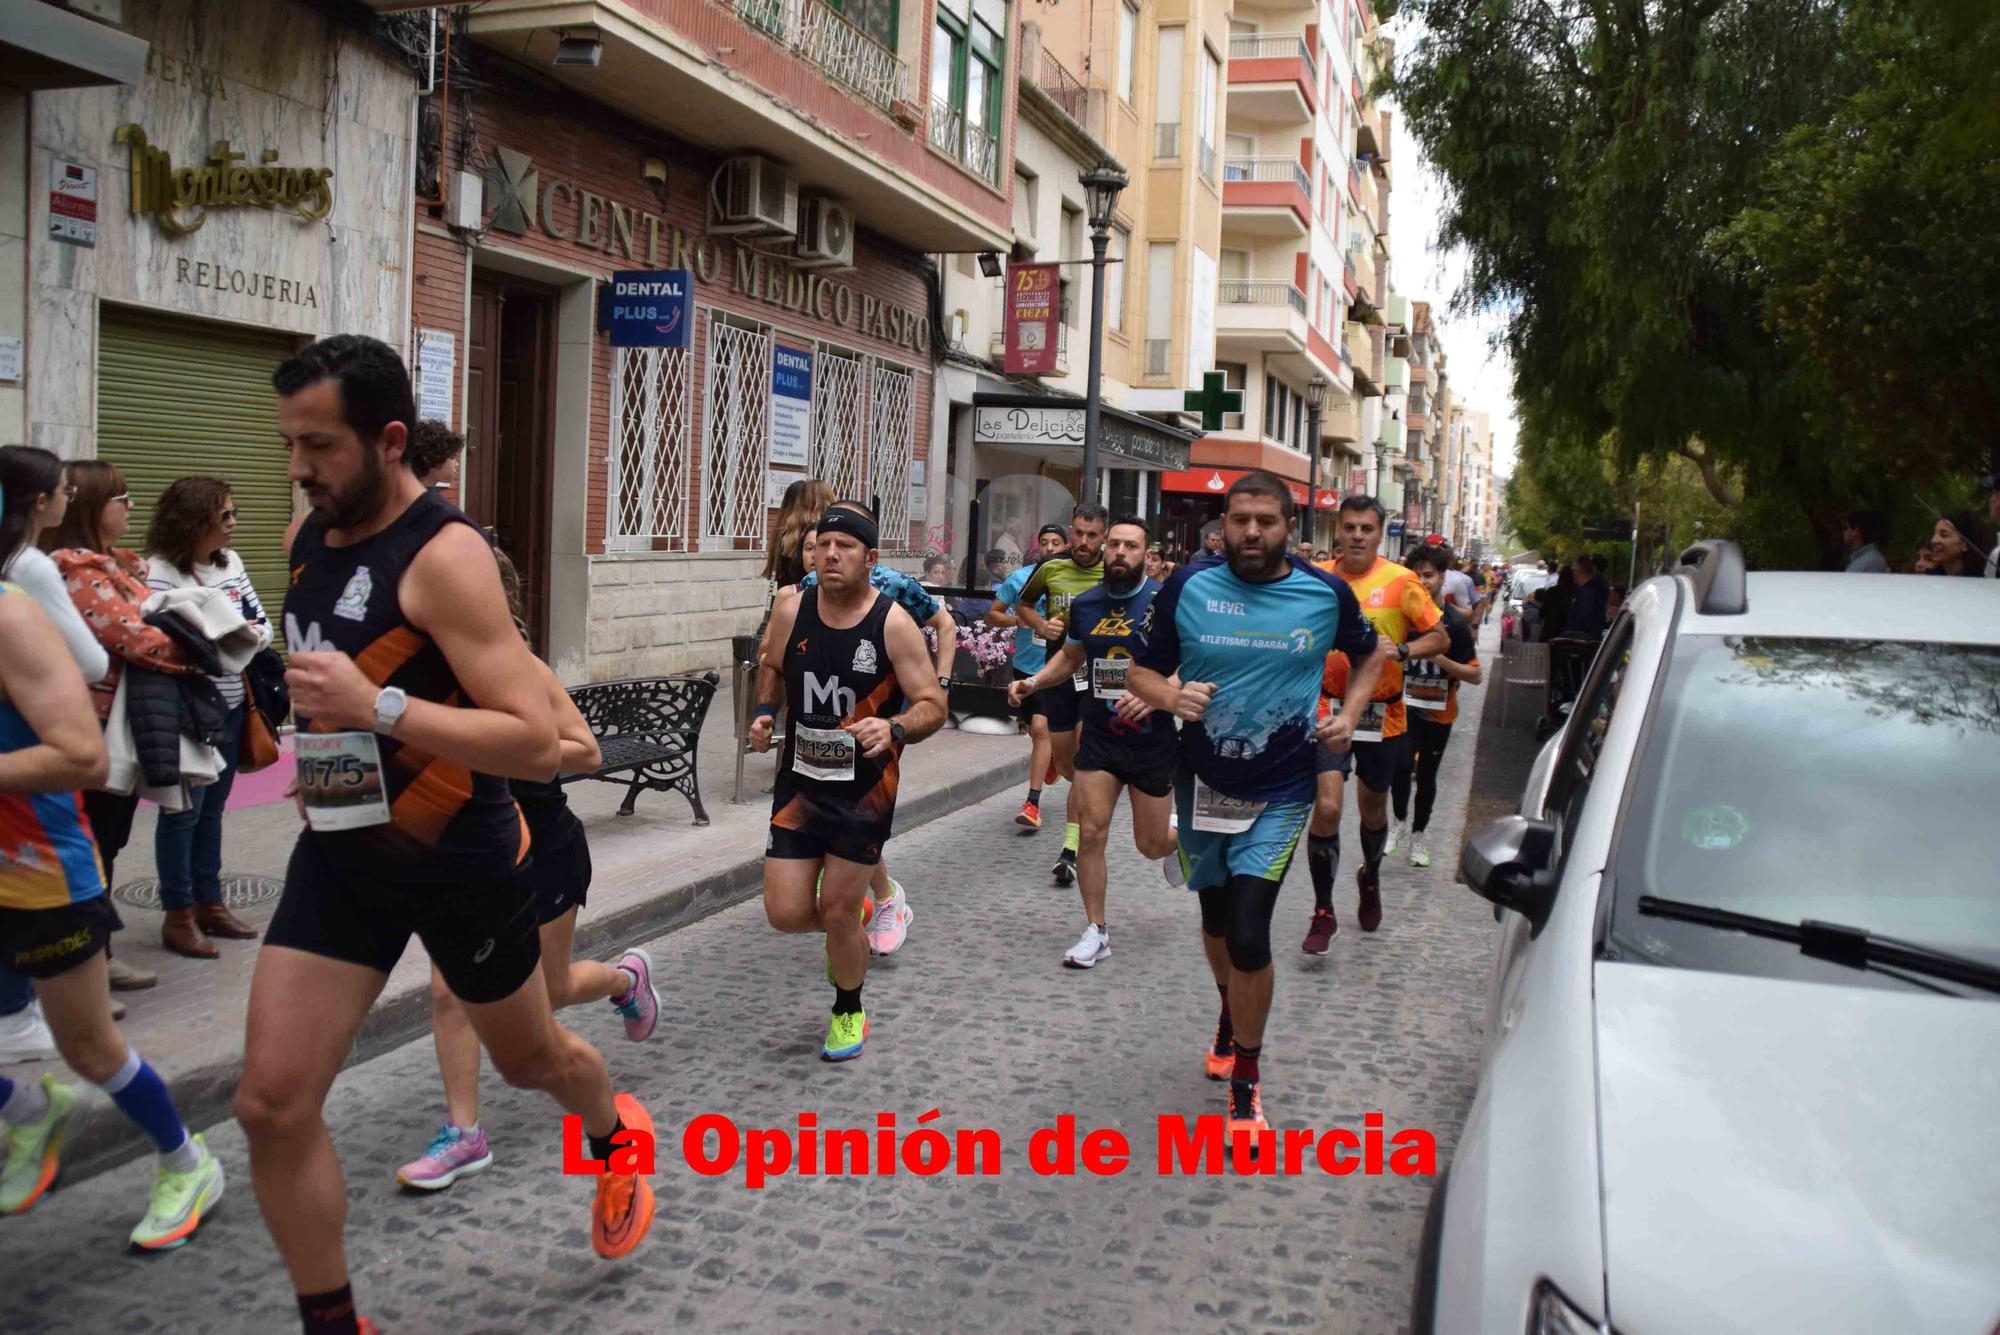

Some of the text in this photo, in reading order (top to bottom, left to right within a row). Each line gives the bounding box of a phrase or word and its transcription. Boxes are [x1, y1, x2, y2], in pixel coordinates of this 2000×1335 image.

[114, 123, 334, 232] Montesinos
[543, 179, 931, 352] CENTRO MEDICO PASEO
[176, 257, 318, 309] RELOJERIA
[615, 282, 684, 297] DENTAL
[613, 306, 658, 320] PLUS
[776, 351, 810, 372] DENTAL
[775, 371, 799, 388] PLUS
[976, 408, 1085, 438] Las Delicias
[1199, 634, 1250, 648] ATLETISMO
[1250, 637, 1289, 651] ABARÁN
